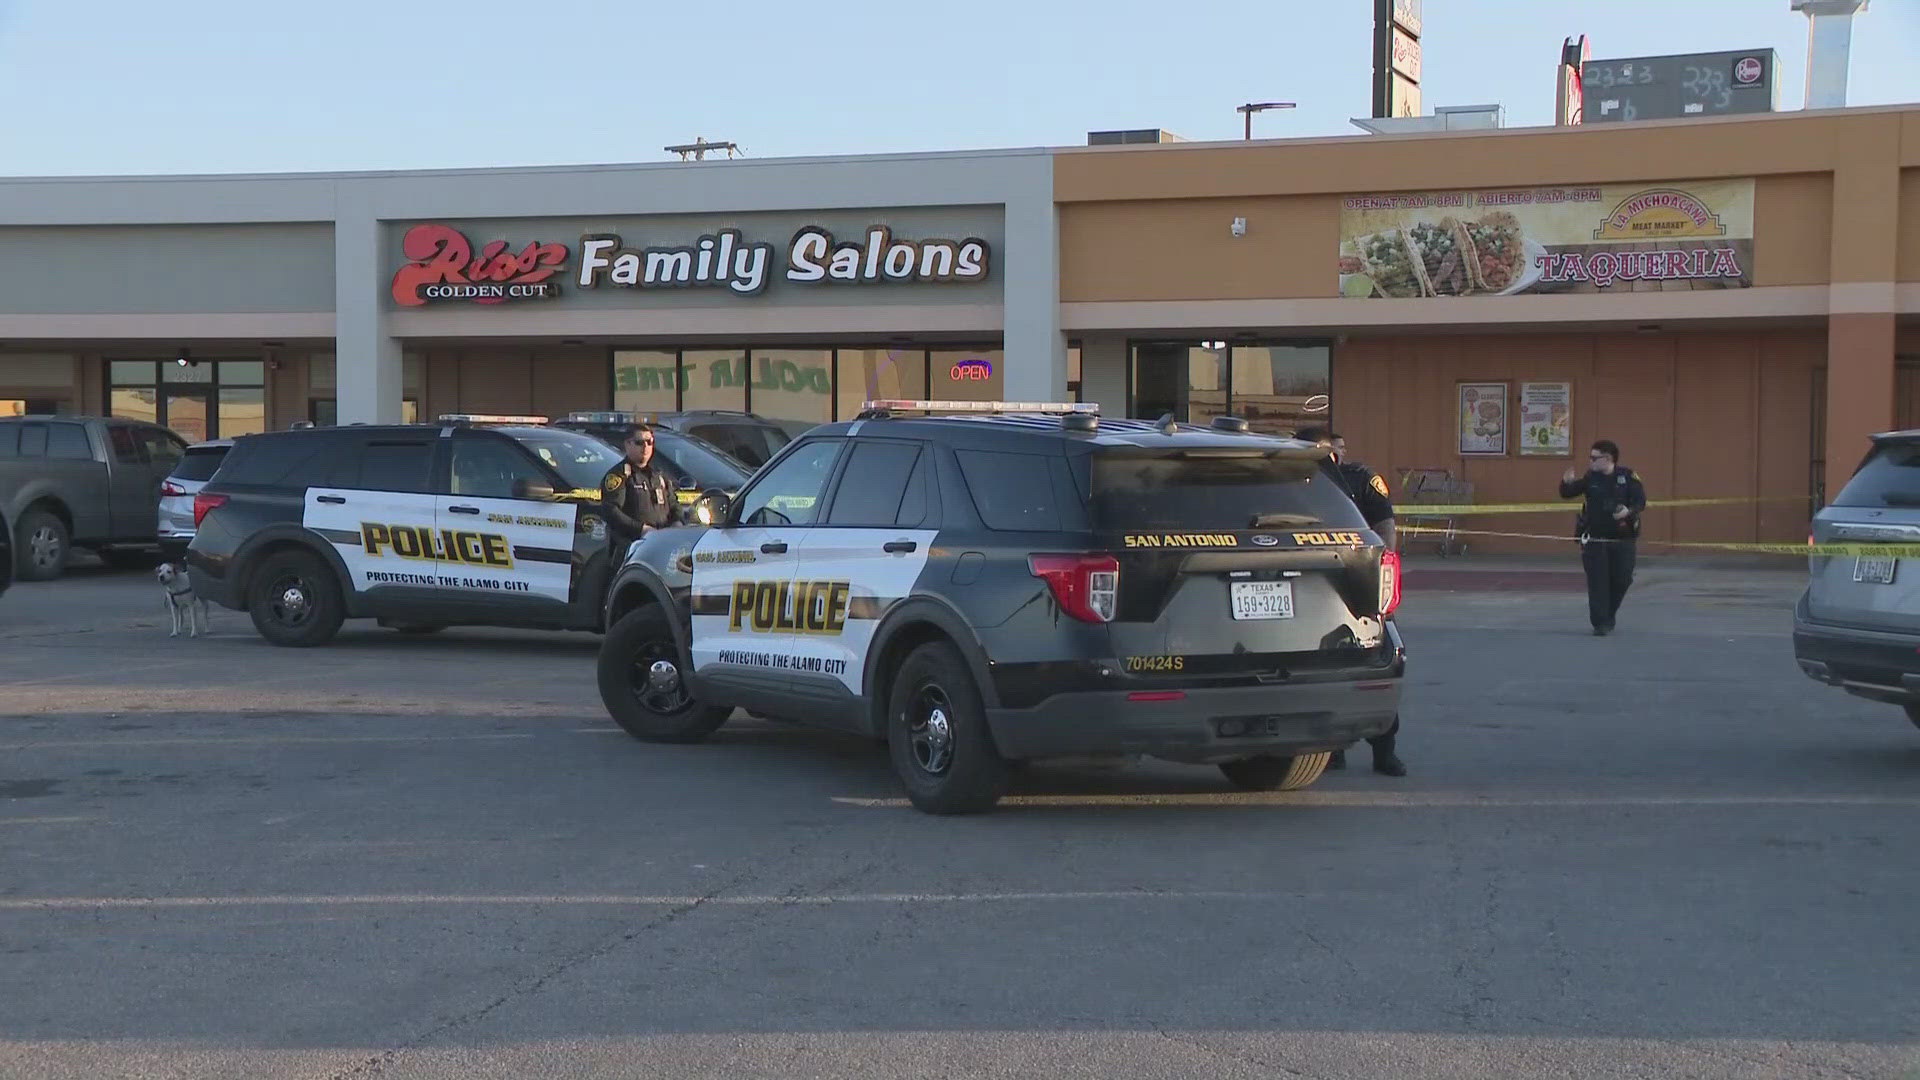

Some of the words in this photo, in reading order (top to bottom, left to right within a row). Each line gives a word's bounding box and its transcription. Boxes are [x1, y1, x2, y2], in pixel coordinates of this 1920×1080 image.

[1346, 198, 1380, 209] OPEN
[1380, 198, 1398, 208] AT
[1476, 192, 1533, 205] ABIERTO
[1612, 214, 1629, 229] LA
[1628, 194, 1707, 226] MICHOACANA
[1632, 222, 1652, 230] MEAT
[1654, 221, 1685, 230] MARKET
[392, 224, 568, 306] Rios
[579, 232, 768, 292] Family
[786, 230, 983, 281] Salons
[1536, 249, 1741, 286] TAQUERIA
[426, 285, 503, 297] GOLDEN
[509, 284, 548, 297] CUT
[950, 365, 989, 380] OPEN
[361, 521, 515, 569] POLICE
[1124, 533, 1161, 547] SAN
[1163, 533, 1239, 548] ANTONIO
[1292, 532, 1364, 546] POLICE
[366, 571, 435, 585] PROTECTING
[438, 576, 460, 587] THE
[462, 578, 500, 590] ALAMO
[504, 580, 529, 592] CITY
[1251, 584, 1273, 592] TEXAS
[728, 578, 850, 636] POLICE
[719, 649, 769, 667] PROTECTING
[772, 654, 789, 668] THE
[790, 655, 821, 672] ALAMO
[824, 658, 848, 675] CITY
[1126, 656, 1183, 671] 701424S
